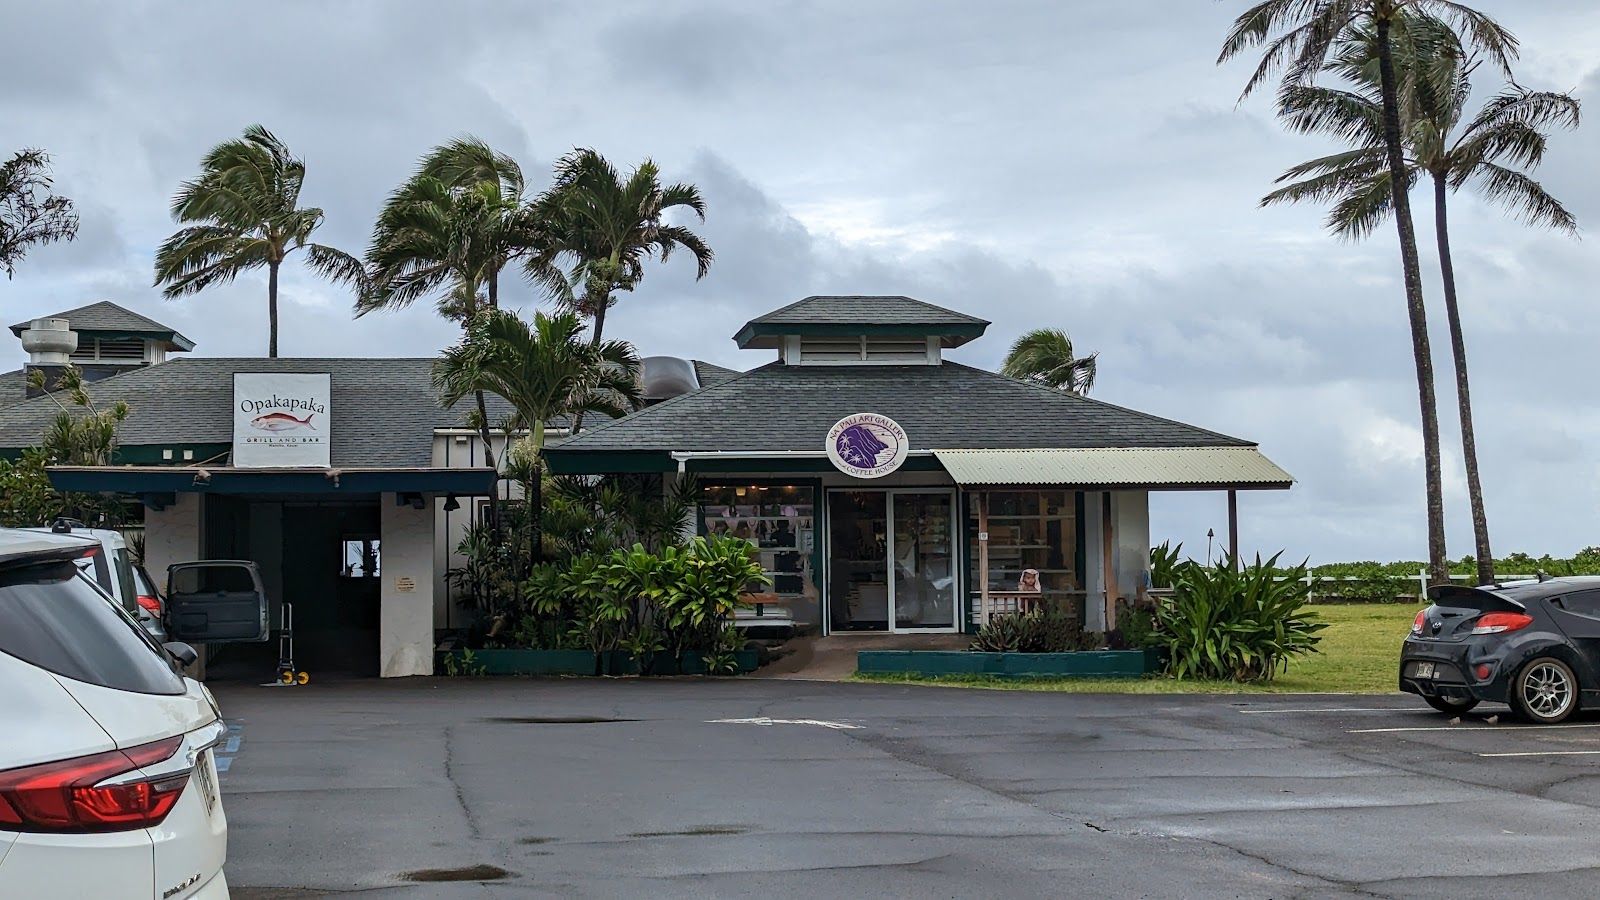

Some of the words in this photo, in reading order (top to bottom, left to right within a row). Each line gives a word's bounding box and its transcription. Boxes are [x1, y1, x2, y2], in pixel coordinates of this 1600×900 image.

[240, 394, 325, 414] Opakapaka
[874, 415, 905, 440] GALLERY
[846, 466, 873, 476] COFFEE
[875, 460, 899, 475] HOUSE
